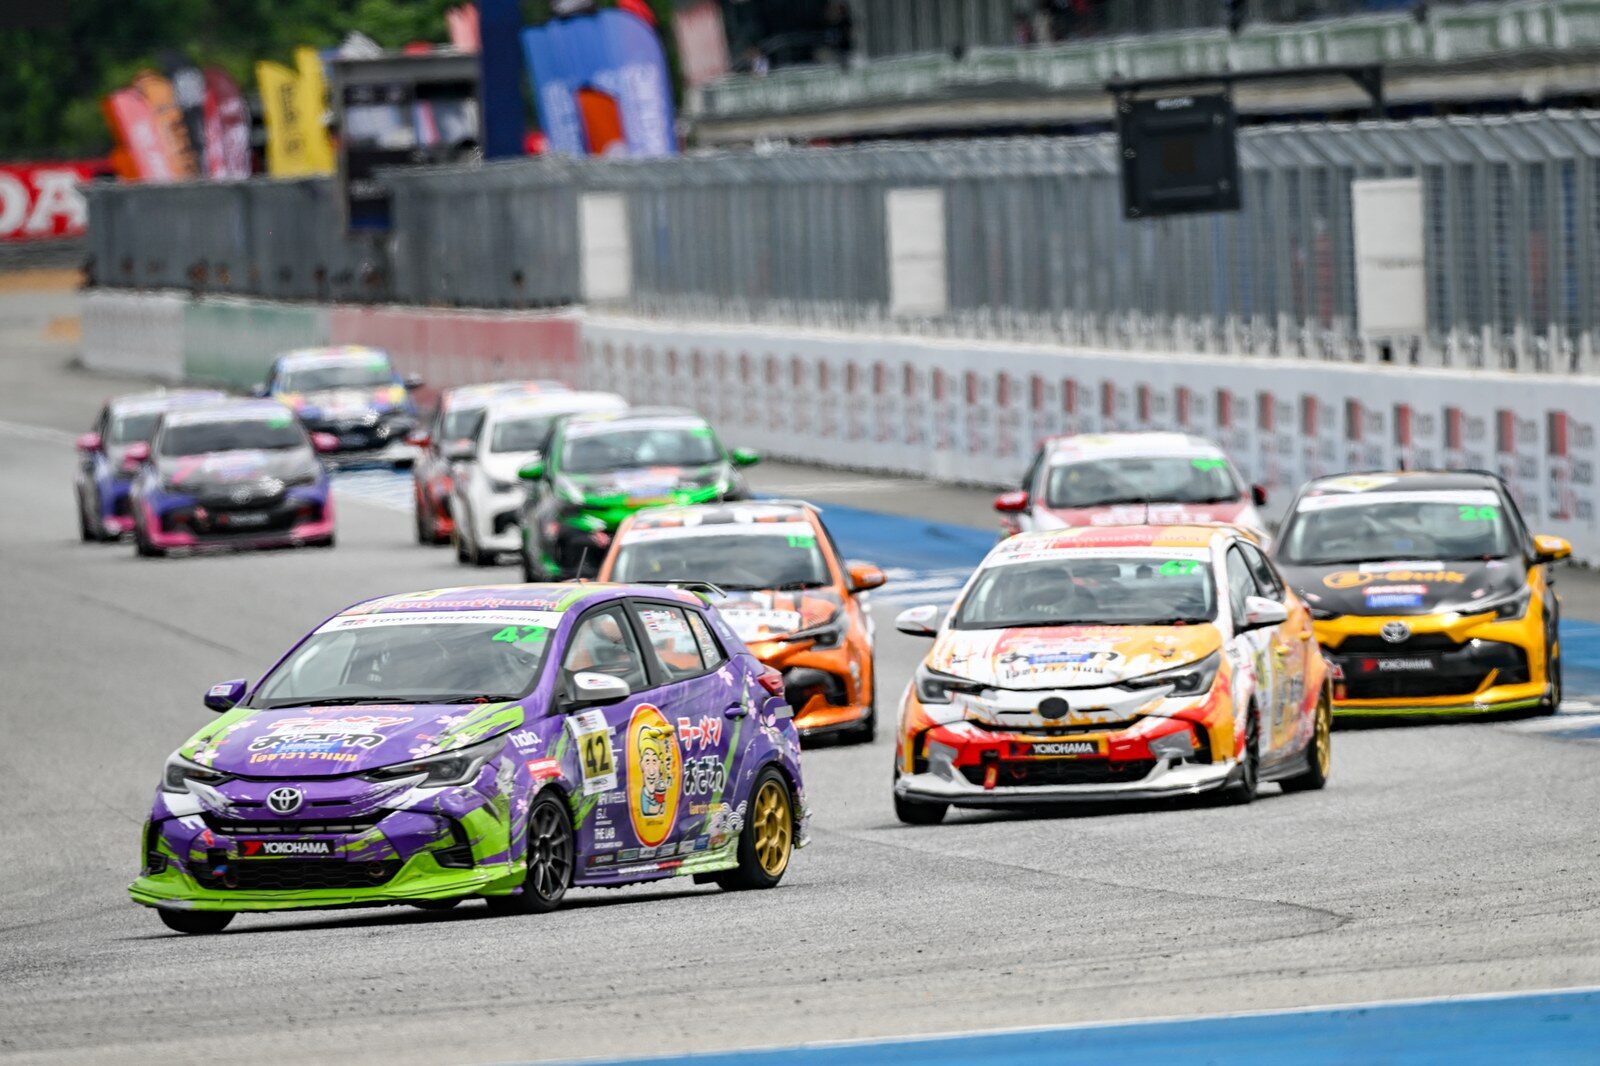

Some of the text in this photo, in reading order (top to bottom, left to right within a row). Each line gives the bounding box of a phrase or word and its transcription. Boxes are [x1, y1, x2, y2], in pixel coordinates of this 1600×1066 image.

[491, 625, 549, 643] 42
[677, 715, 722, 751] ラーメン
[586, 735, 612, 773] 42
[1032, 742, 1095, 754] YOKOHAMA
[262, 842, 329, 854] YOKOHAMA
